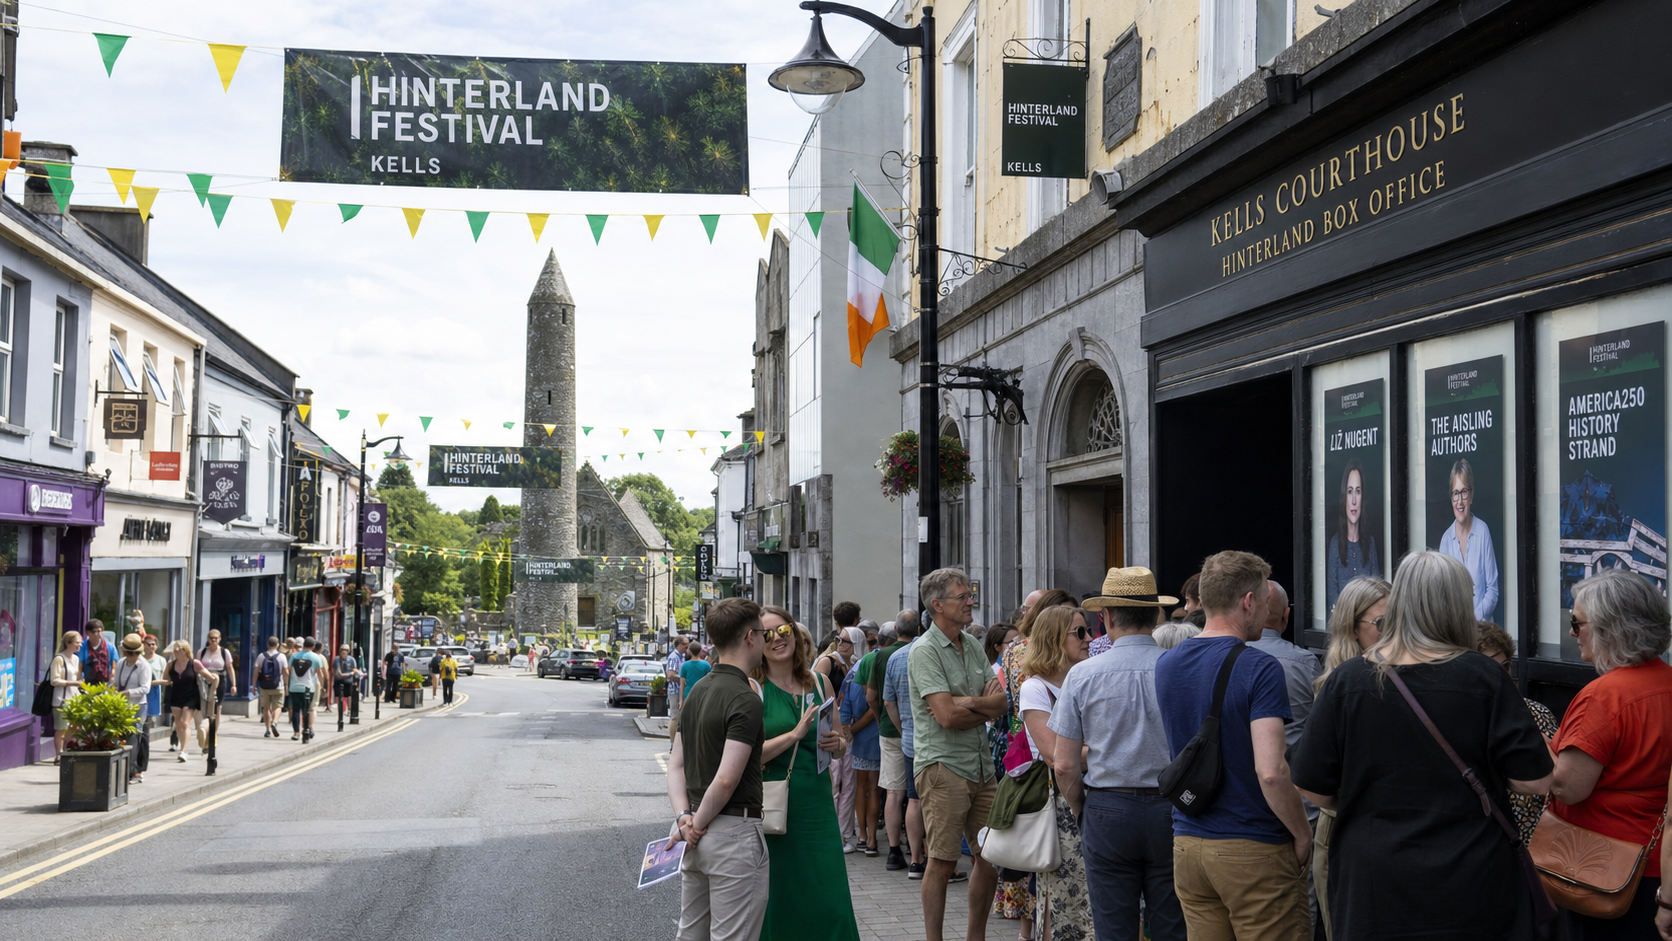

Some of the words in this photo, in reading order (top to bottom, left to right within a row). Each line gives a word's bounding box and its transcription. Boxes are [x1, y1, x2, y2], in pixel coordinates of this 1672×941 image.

[371, 75, 610, 112] HINTERLAND
[1008, 102, 1078, 116] HINTERLAND
[1008, 114, 1059, 126] FESTIVAL
[371, 111, 543, 146] FESTIVAL
[371, 155, 441, 175] KELLS
[1007, 161, 1042, 172] KELLS
[1210, 194, 1266, 247] KELLS
[1275, 92, 1466, 214] COURTHOUSE
[1222, 219, 1315, 278] HINTERLAND
[1323, 198, 1360, 236] BOX
[1369, 160, 1446, 215] OFFICE
[1568, 386, 1645, 416] AMERICA250
[1431, 416, 1449, 436] THE
[1452, 409, 1493, 433] AISLING
[1568, 412, 1620, 438] HISTORY
[1344, 427, 1378, 450] NUGENT
[1431, 433, 1477, 456] AUTHORS
[1568, 436, 1616, 461] STRAND
[449, 463, 500, 475] FESTIVAL
[450, 452, 521, 464] HINTERLAND
